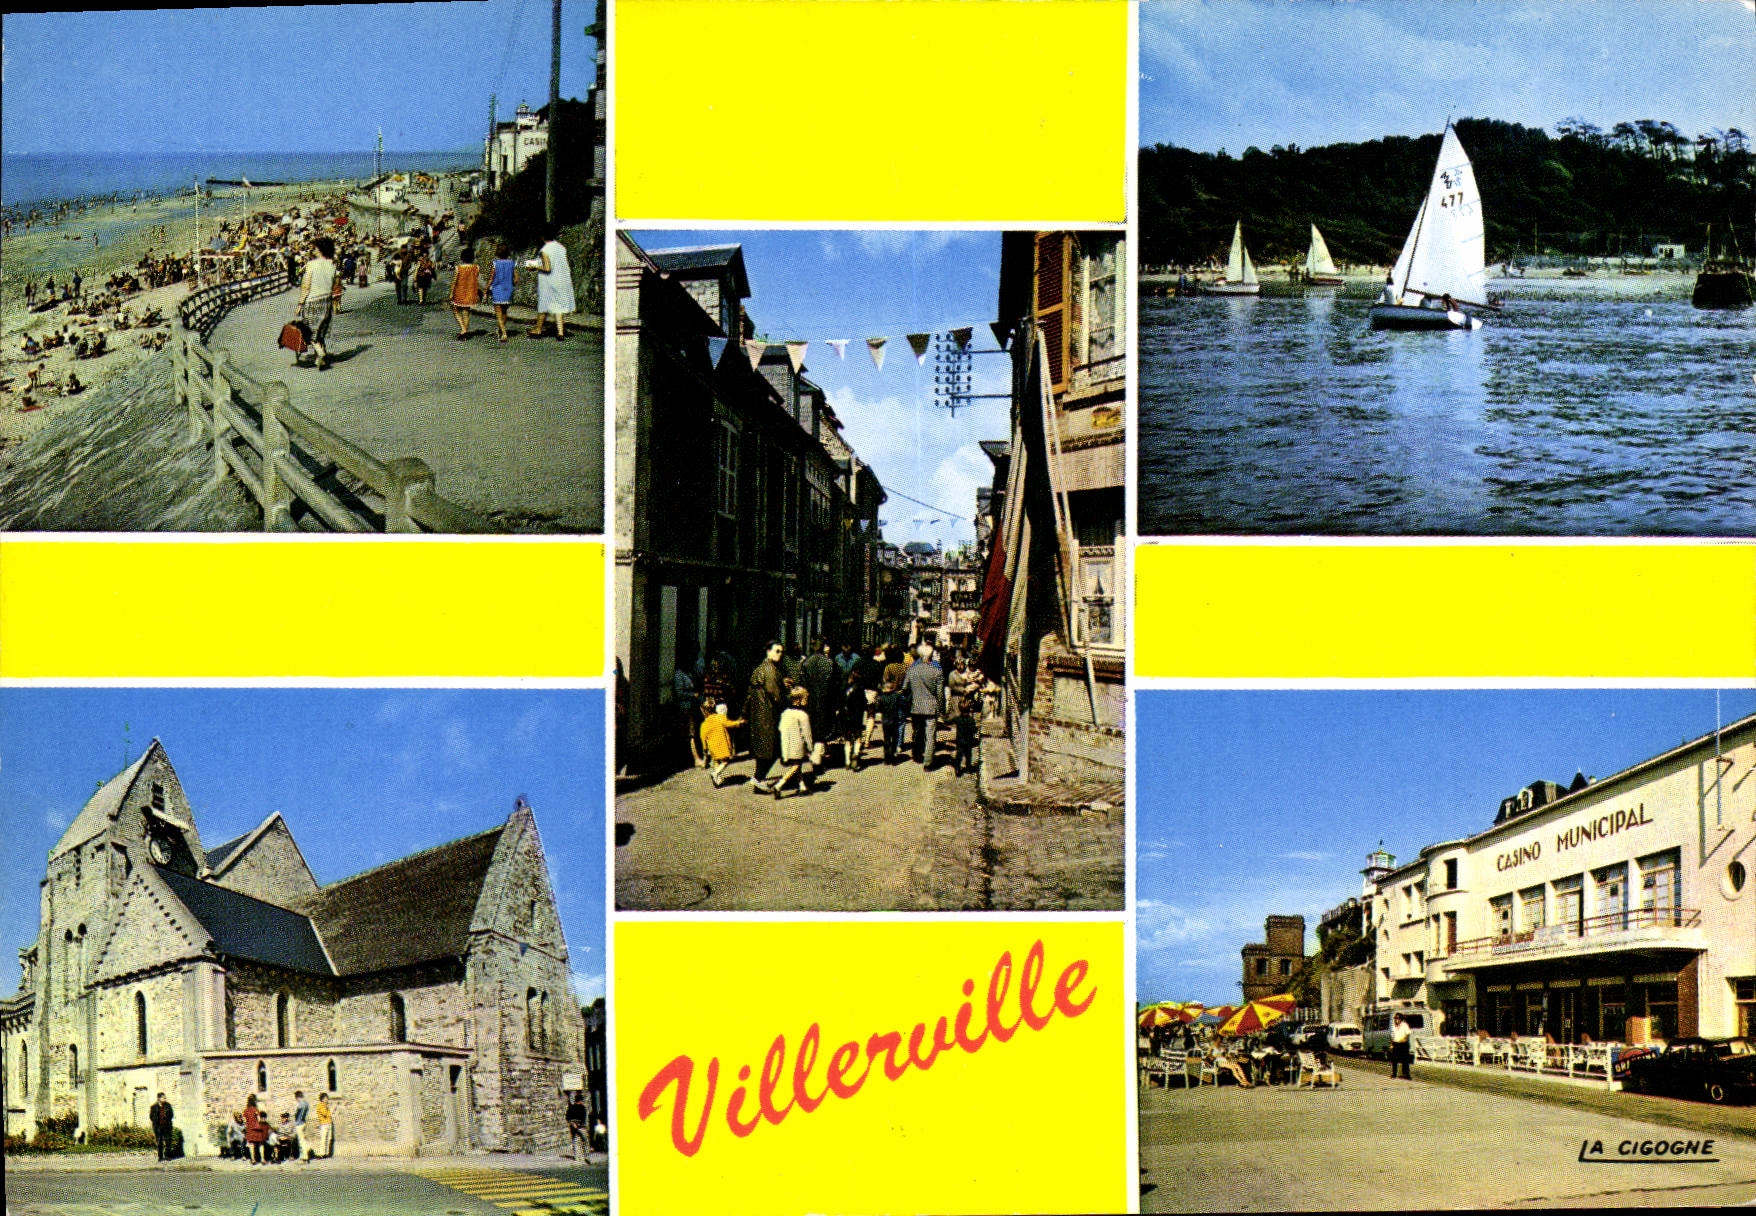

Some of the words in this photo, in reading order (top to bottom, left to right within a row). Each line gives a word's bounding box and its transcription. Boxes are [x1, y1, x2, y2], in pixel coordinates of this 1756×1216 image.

[1441, 192, 1464, 208] 477
[1497, 841, 1541, 872] CASINO
[1557, 802, 1654, 852] MUNICIPAL
